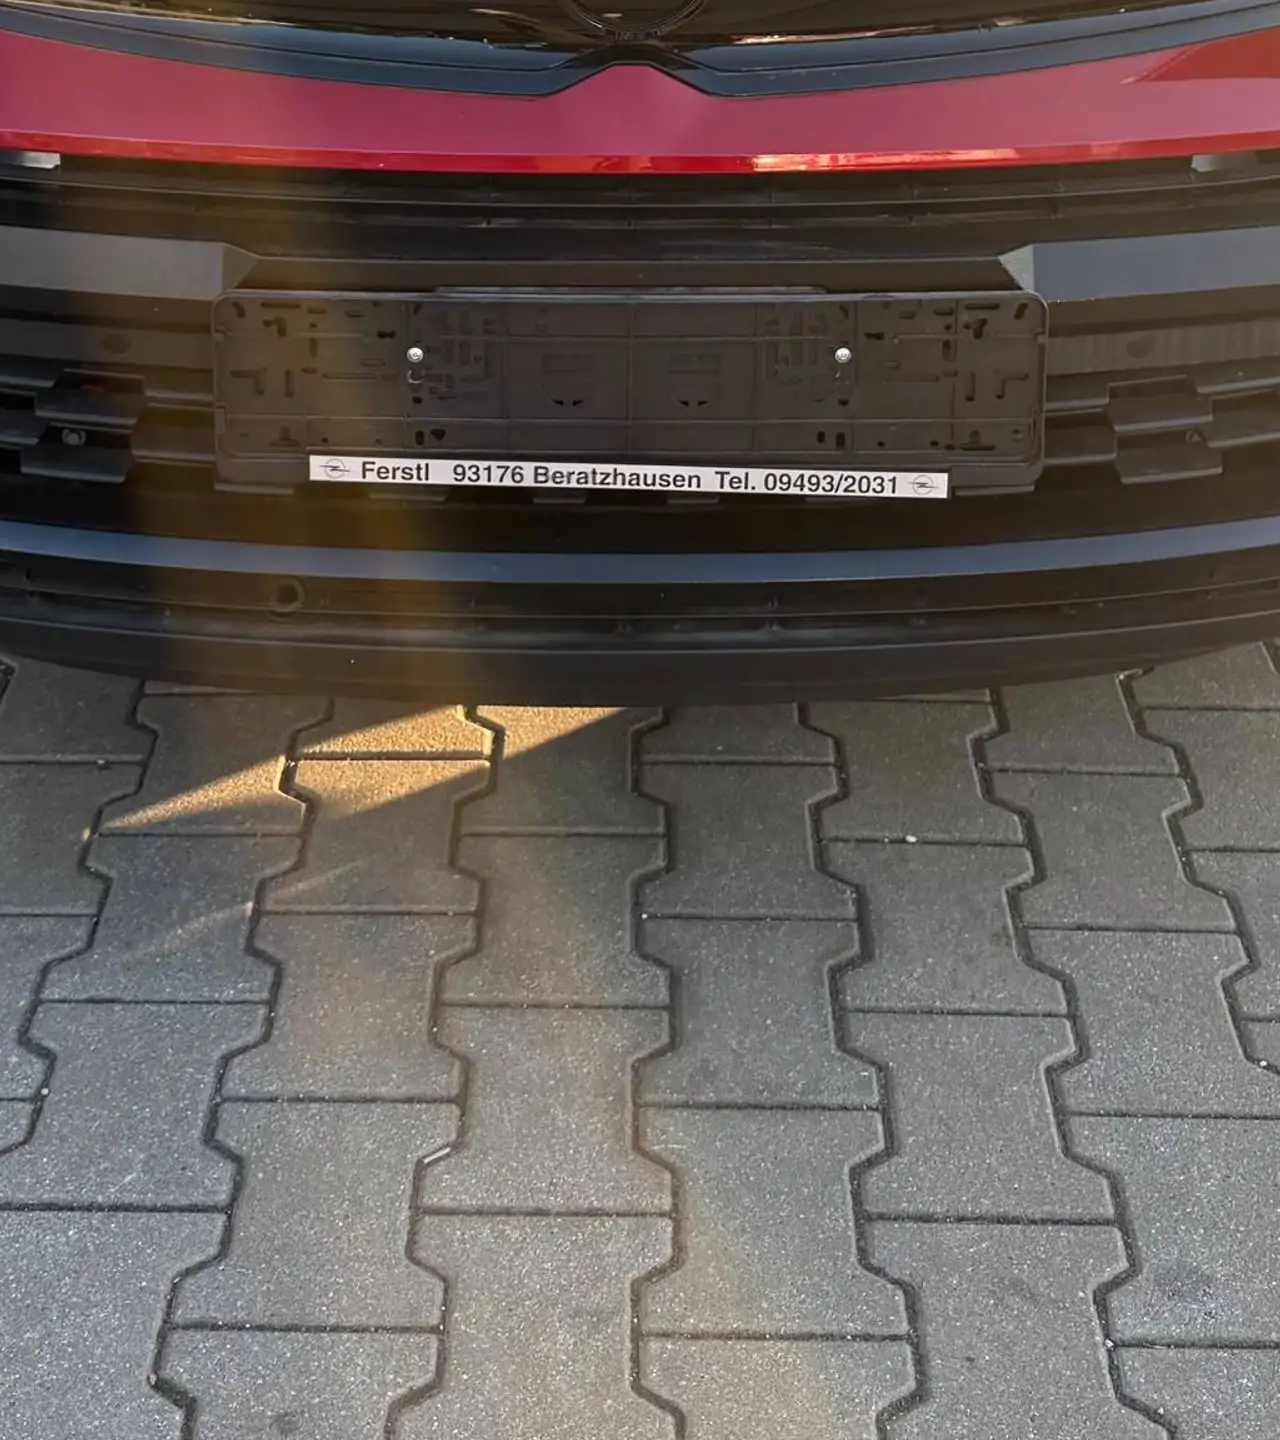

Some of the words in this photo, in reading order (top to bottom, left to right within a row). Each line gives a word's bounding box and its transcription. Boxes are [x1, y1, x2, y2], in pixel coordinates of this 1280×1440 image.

[361, 461, 430, 482] Ferstl
[452, 463, 524, 484] 93176
[532, 465, 702, 490] Beratzhausen
[714, 470, 756, 491] Tel.
[763, 471, 898, 494] 09493/2031
